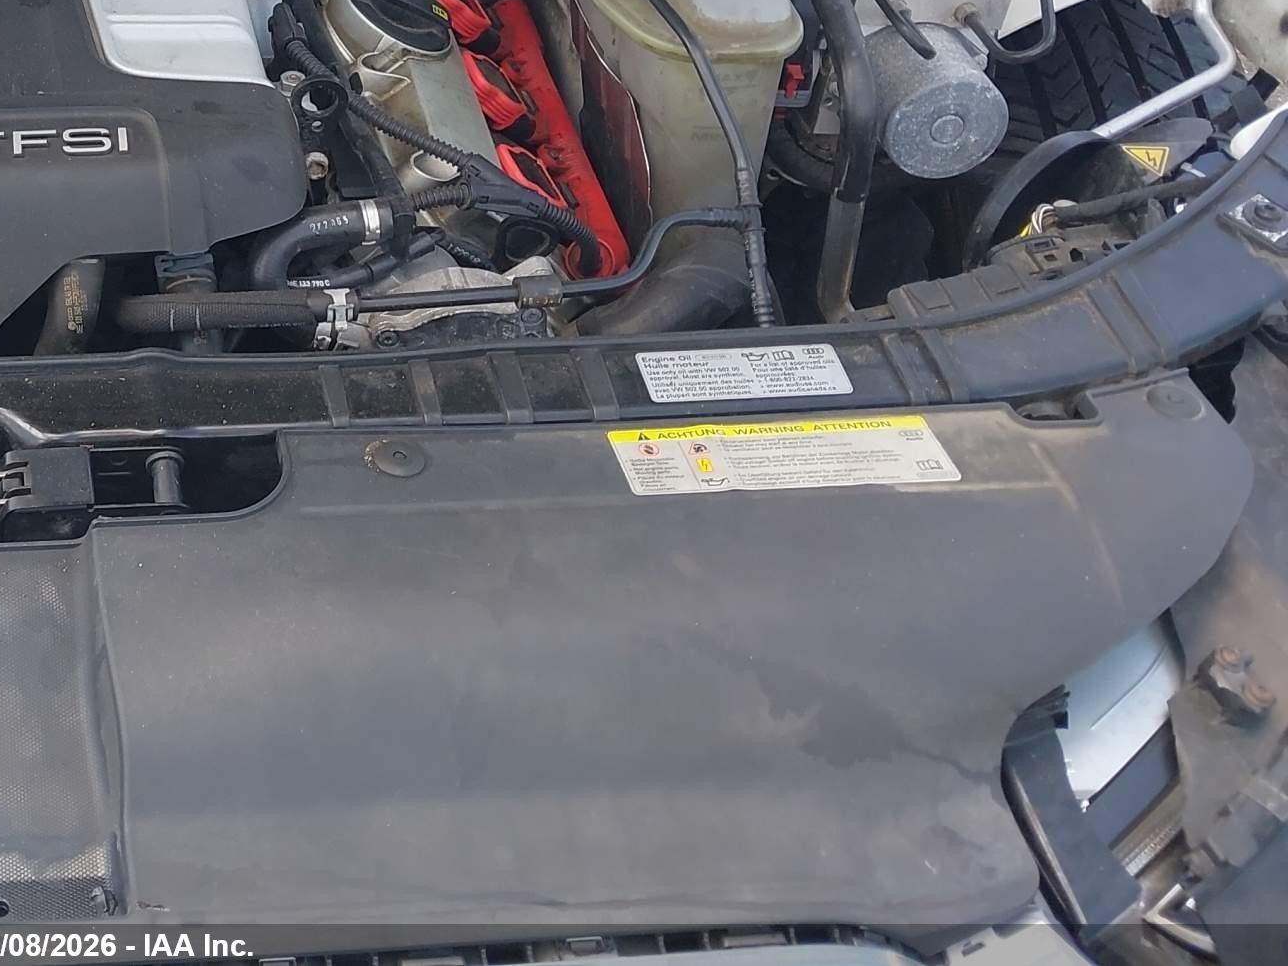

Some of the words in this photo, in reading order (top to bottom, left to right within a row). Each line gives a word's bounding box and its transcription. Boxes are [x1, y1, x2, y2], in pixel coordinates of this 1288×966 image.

[641, 355, 676, 363] Engine
[657, 428, 726, 440] ACHTUNG
[732, 424, 805, 436] WARNING
[813, 420, 892, 432] ATTENTION
